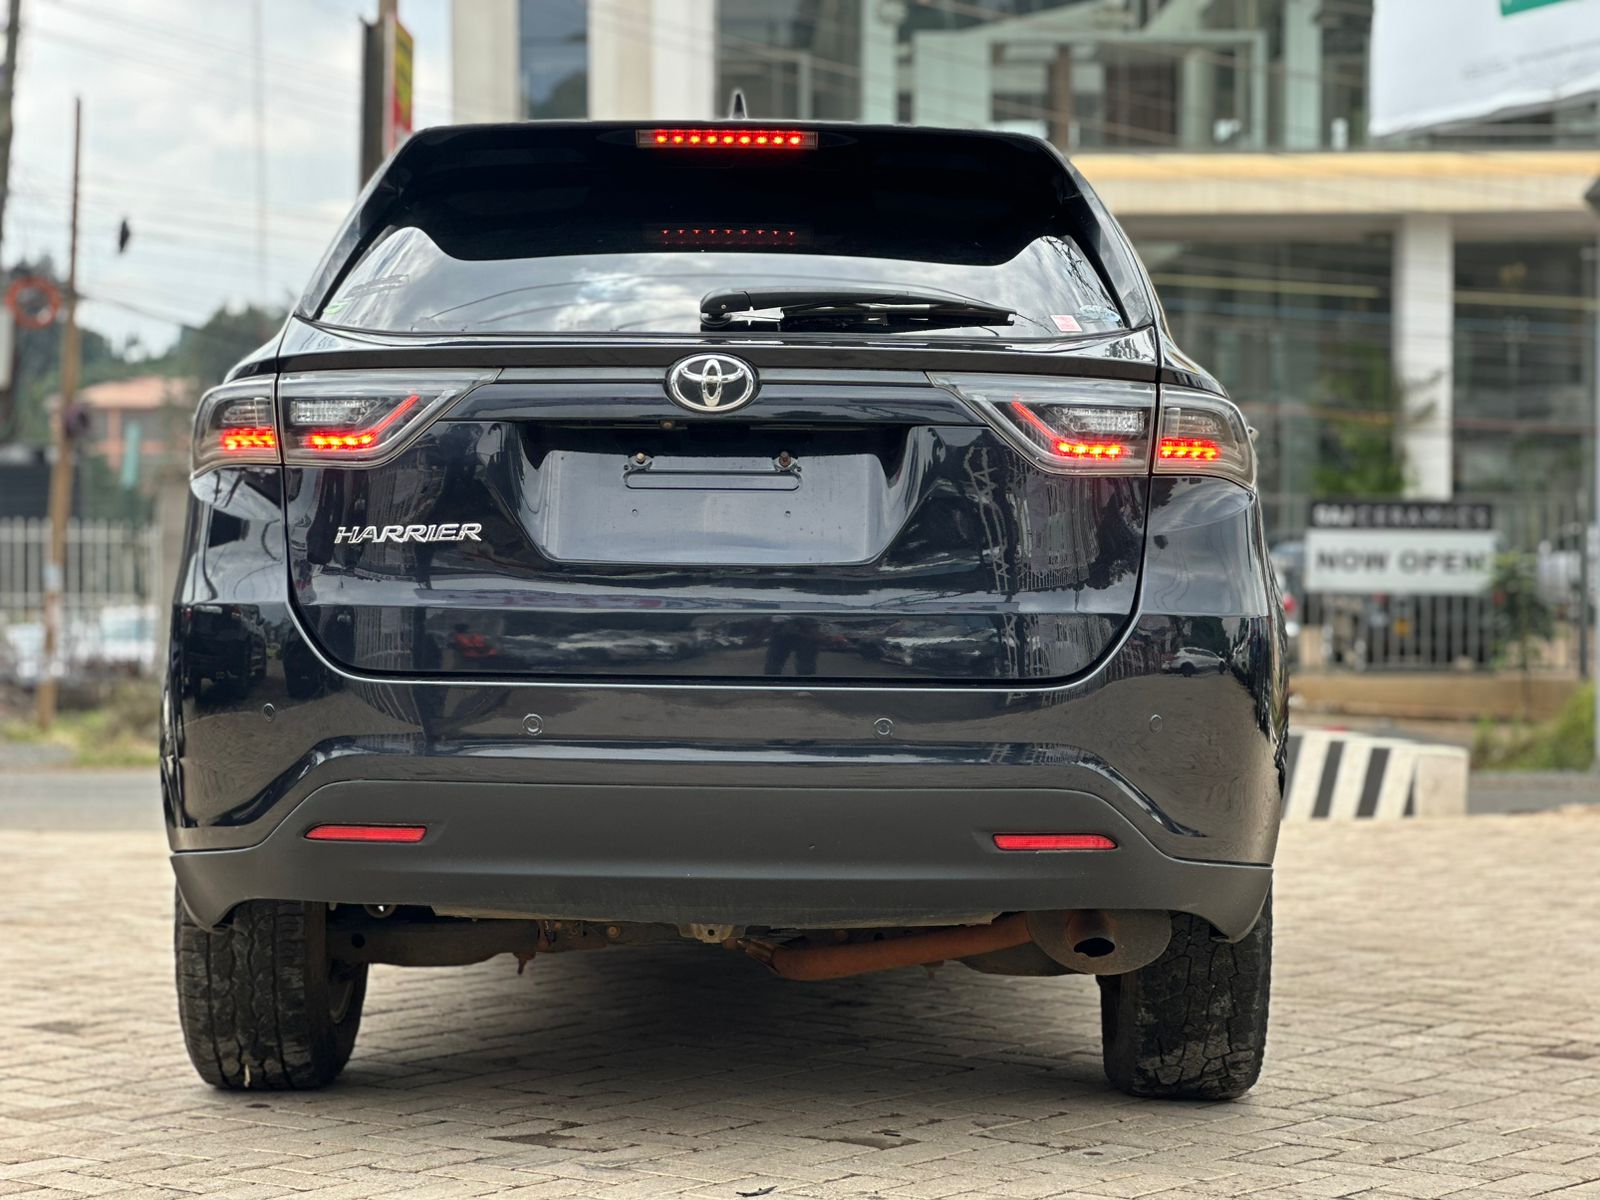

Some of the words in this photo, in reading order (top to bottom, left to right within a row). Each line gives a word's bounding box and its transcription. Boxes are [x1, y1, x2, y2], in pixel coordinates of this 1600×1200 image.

[334, 523, 482, 544] HARRIER
[1317, 550, 1389, 573] NOW
[1399, 550, 1486, 575] OPEN
